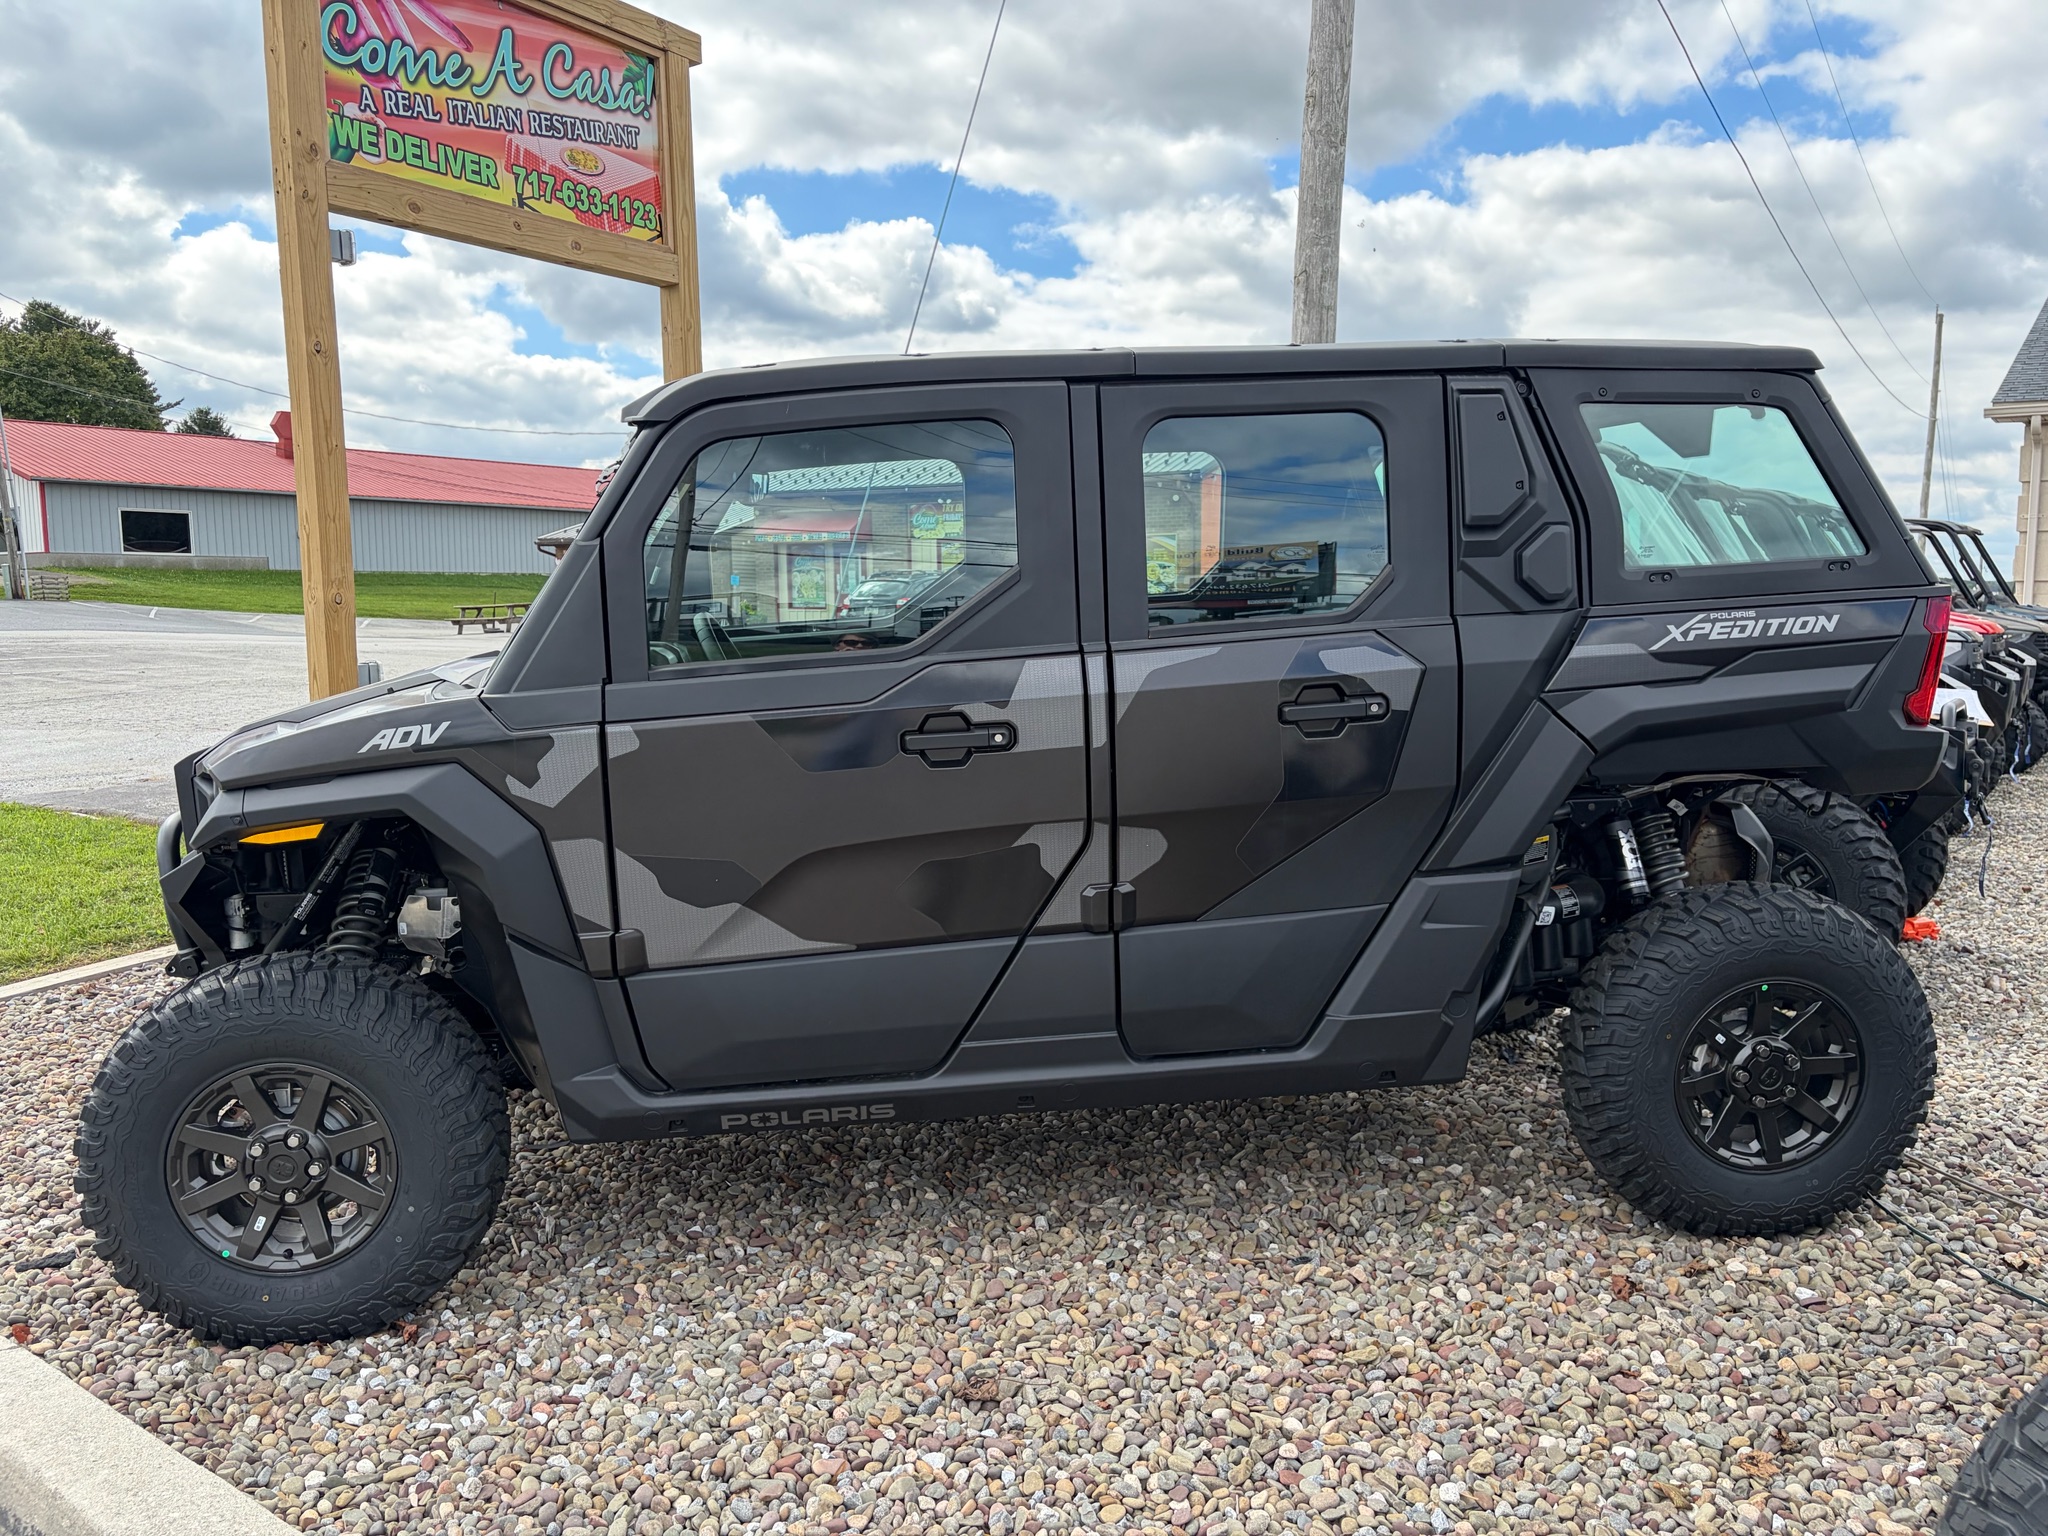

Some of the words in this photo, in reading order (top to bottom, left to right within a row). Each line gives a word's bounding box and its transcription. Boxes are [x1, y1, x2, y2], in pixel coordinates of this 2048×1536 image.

[320, 2, 472, 88] Come
[472, 28, 533, 97] A
[543, 43, 655, 120] Casa!
[359, 87, 377, 113] A
[384, 88, 440, 121] REAL
[447, 98, 523, 133] ITALIAN
[528, 111, 640, 149] RESTAURANT
[332, 113, 380, 157] WE
[385, 131, 500, 190] DELIVER
[512, 165, 658, 231] 717-633-1123
[1648, 613, 1840, 651] XPEDITION
[1710, 610, 1756, 620] POLARIS
[357, 720, 452, 754] ADV
[720, 1103, 896, 1130] POLARIS
